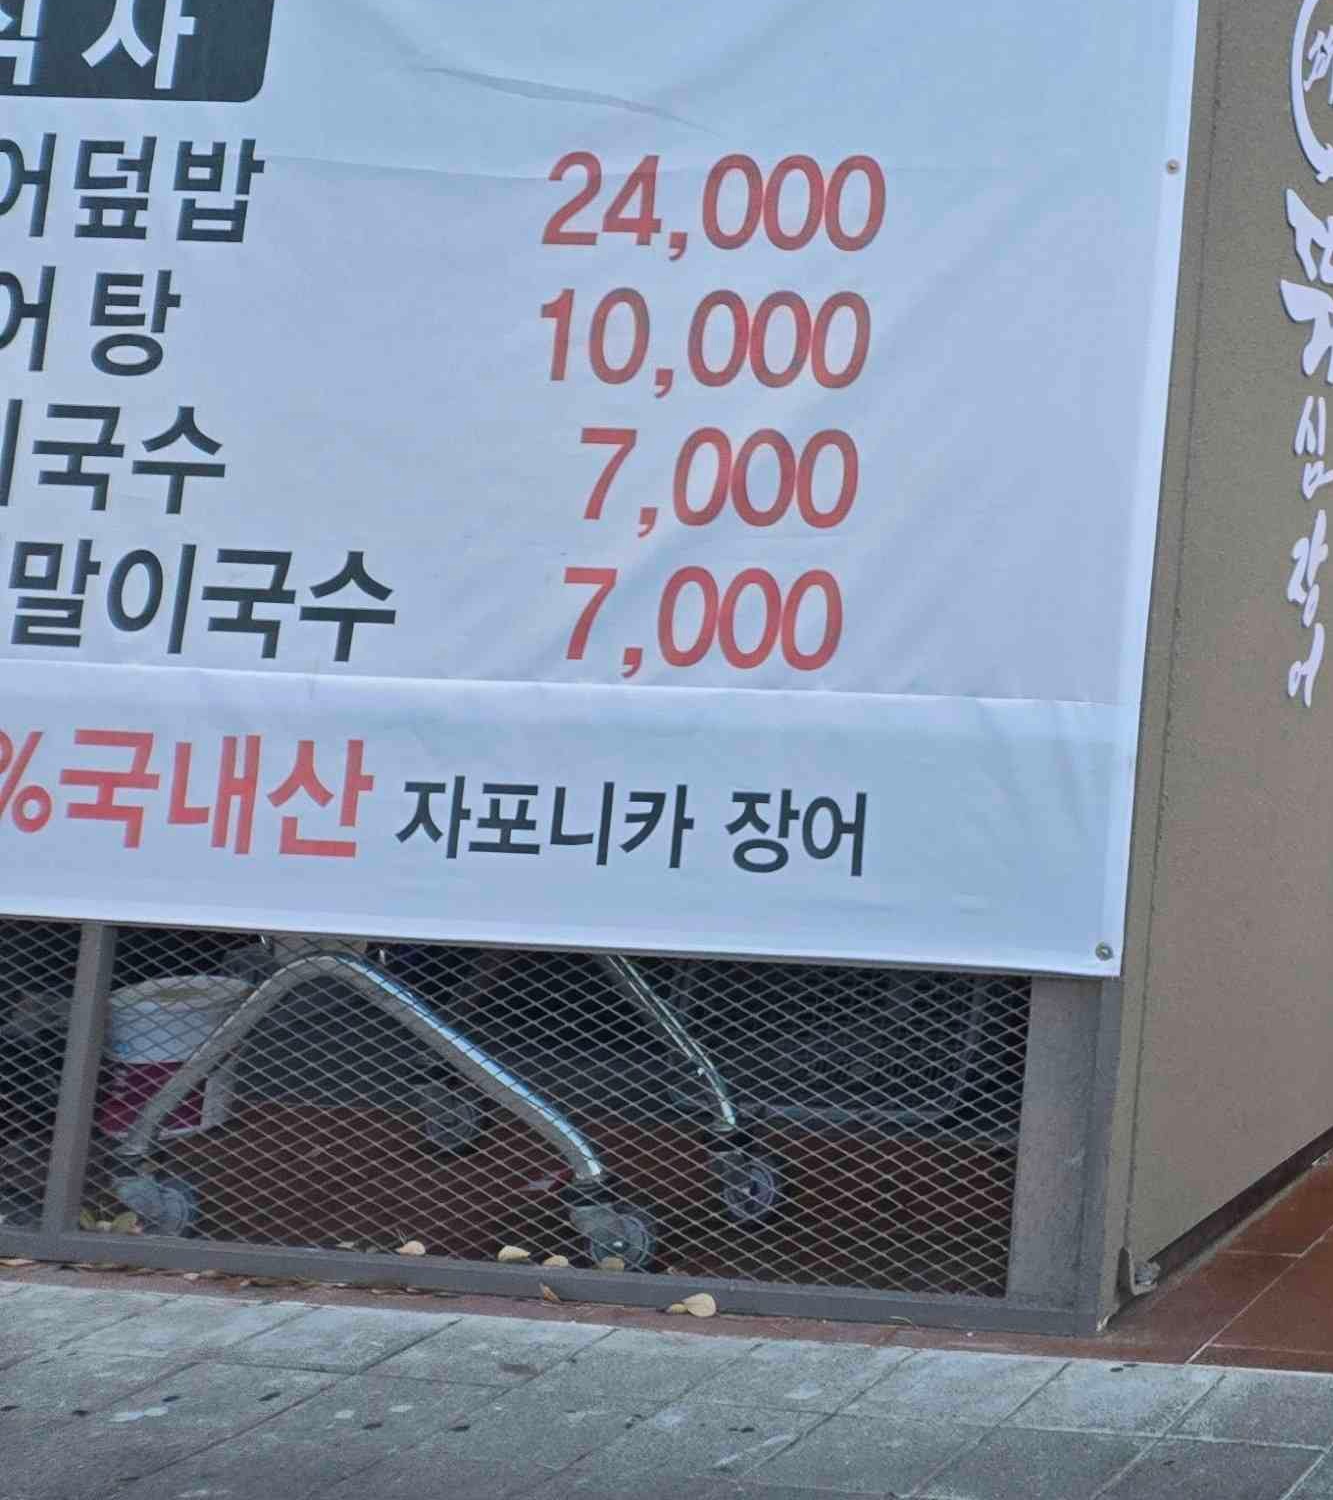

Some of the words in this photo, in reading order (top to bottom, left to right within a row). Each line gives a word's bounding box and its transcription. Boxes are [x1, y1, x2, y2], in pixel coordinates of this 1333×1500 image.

[0, 132, 265, 243] 어덮밥
[541, 151, 887, 261] 24,000
[540, 287, 871, 399] 10,000
[579, 427, 860, 538] 7,000
[8, 539, 397, 662] 말이국수
[562, 565, 843, 679] 7,000
[395, 776, 695, 869] 자포니카
[724, 789, 869, 877] 장어
